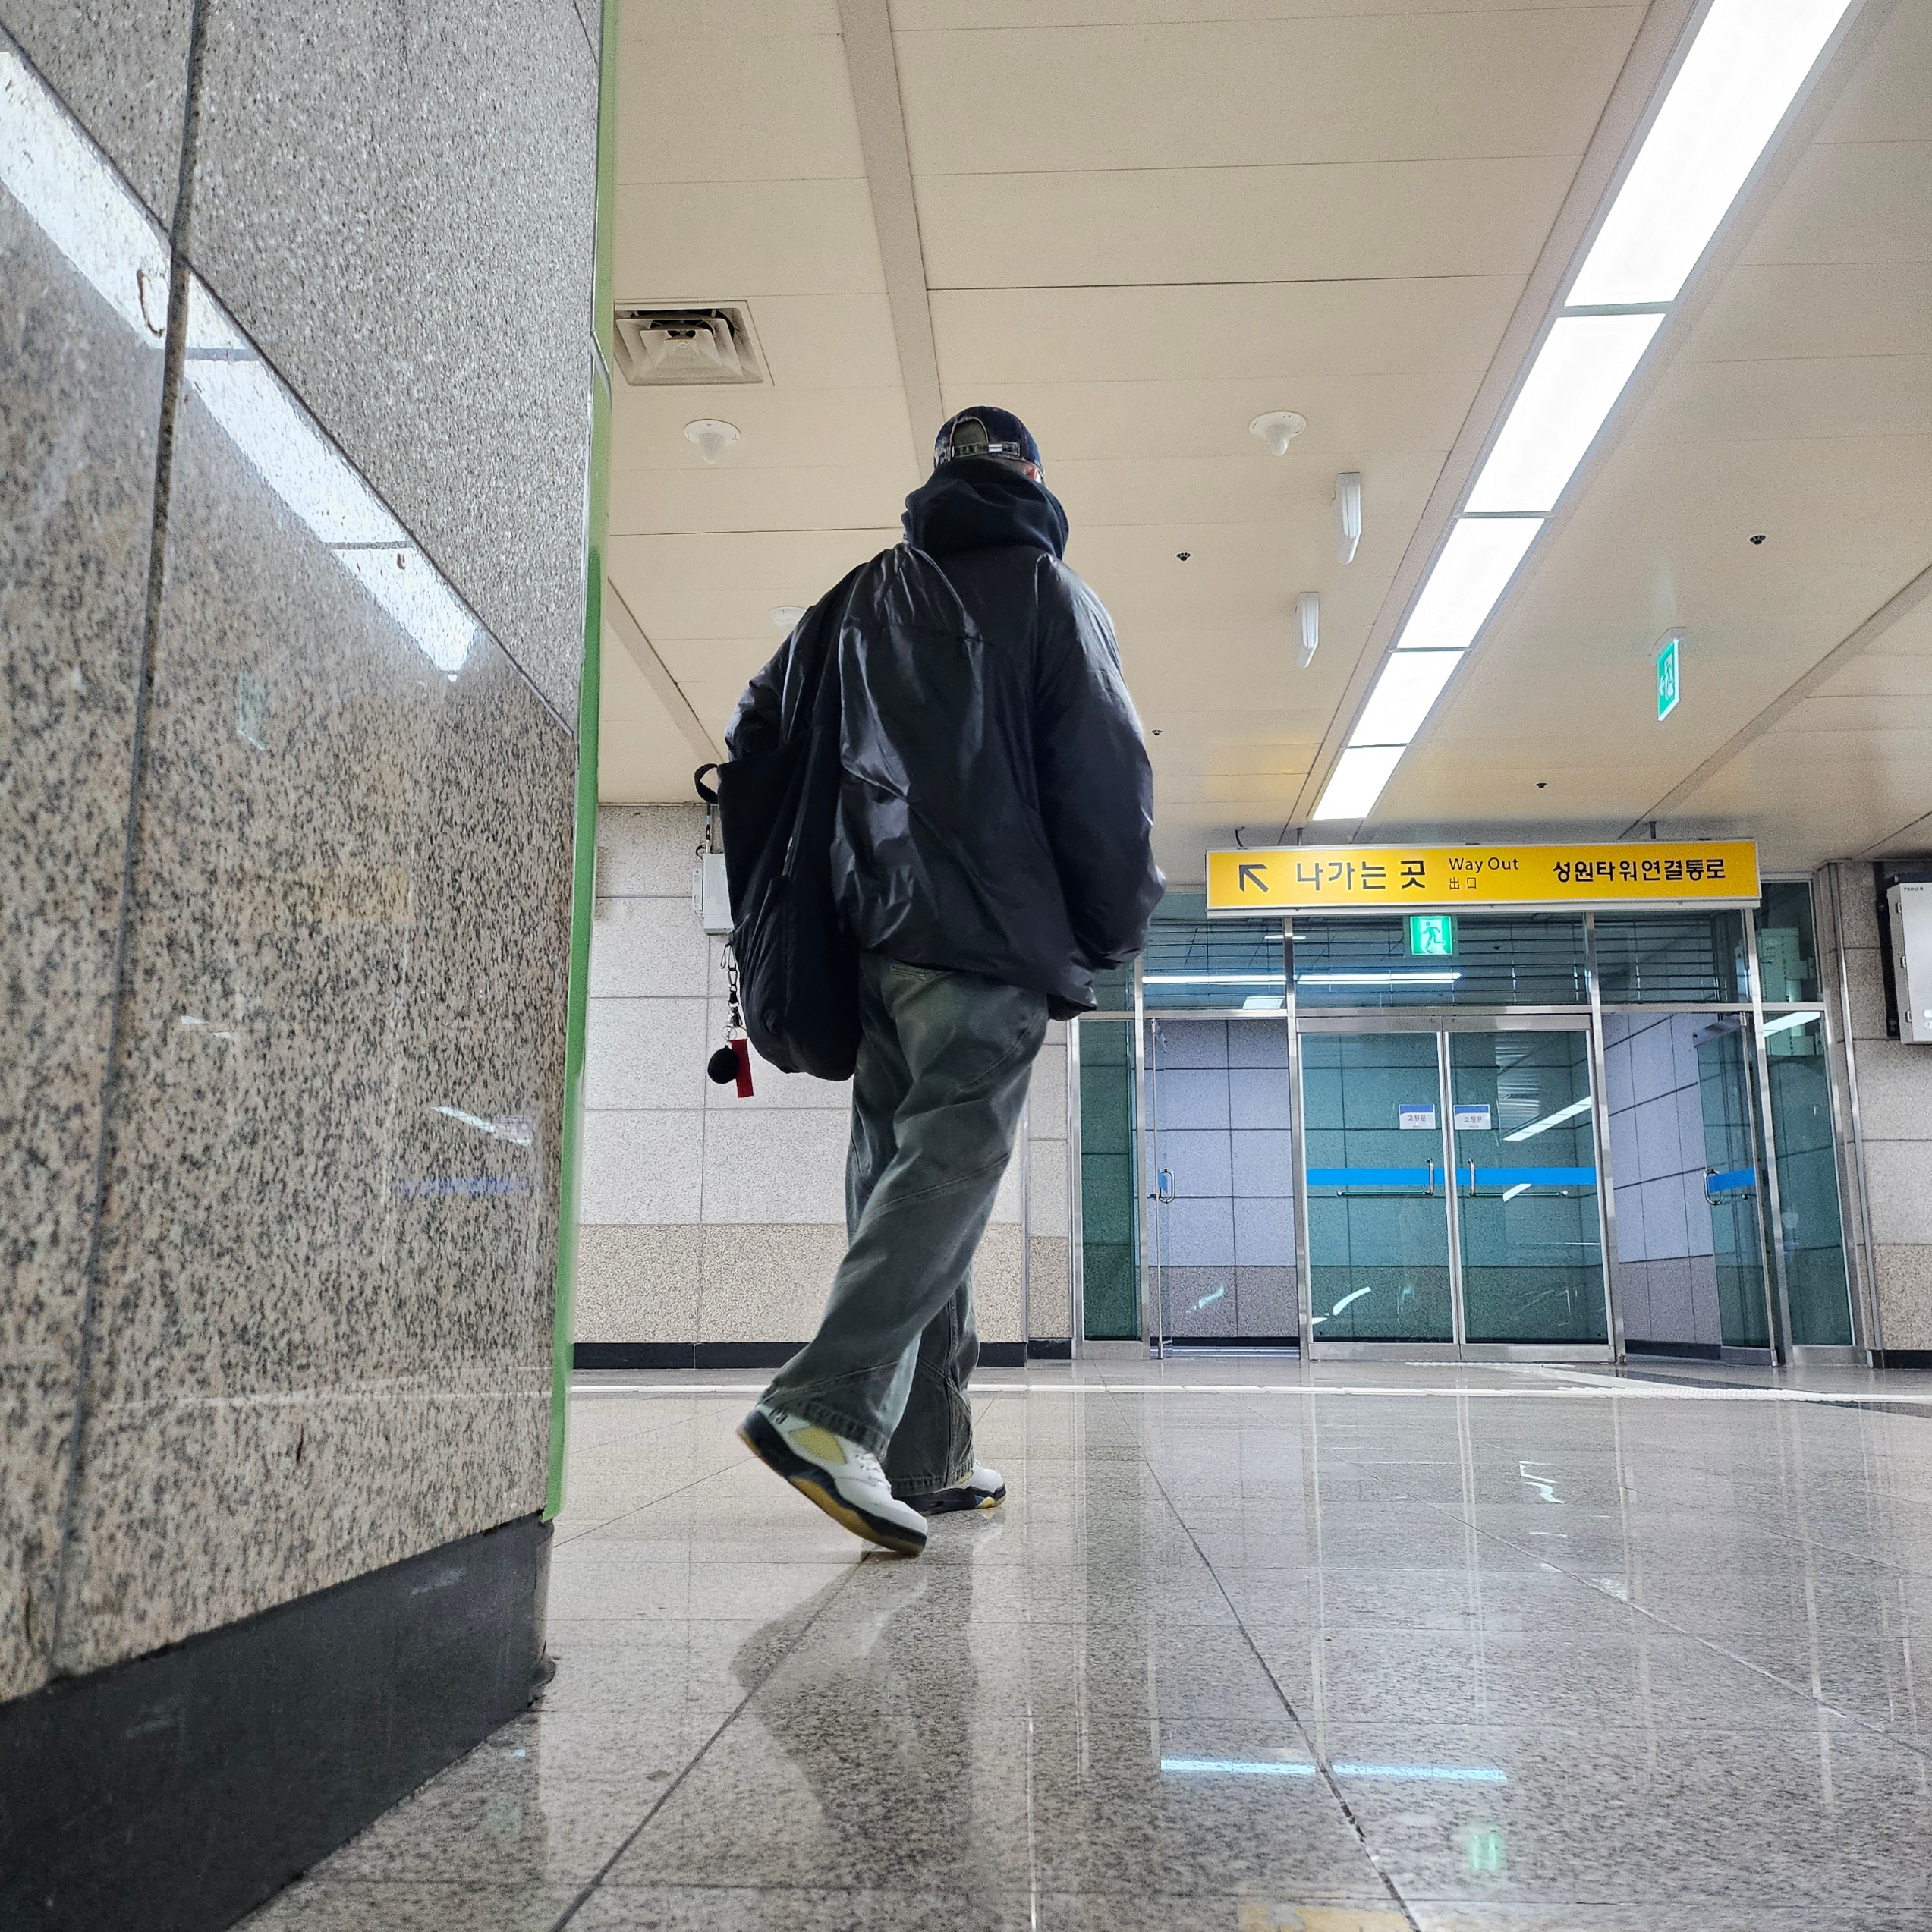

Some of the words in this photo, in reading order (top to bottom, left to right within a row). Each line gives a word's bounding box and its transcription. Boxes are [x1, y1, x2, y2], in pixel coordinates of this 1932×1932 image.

[1296, 861, 1386, 891] 나가는
[1400, 860, 1426, 889] 곳
[1449, 857, 1484, 874] Way
[1487, 857, 1519, 870] Out
[1552, 858, 1726, 883] 성원타워연결통로
[1449, 876, 1477, 890] 出口
